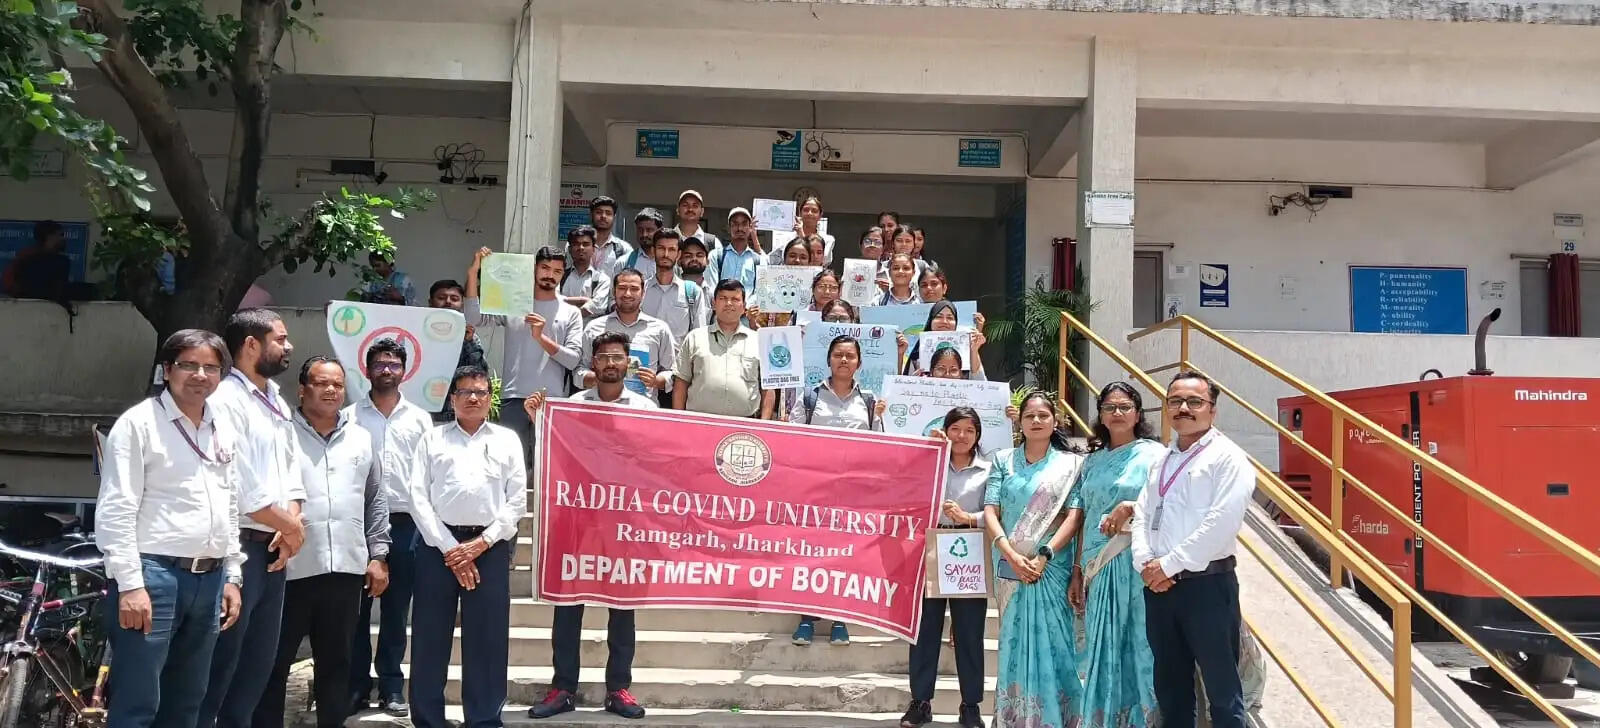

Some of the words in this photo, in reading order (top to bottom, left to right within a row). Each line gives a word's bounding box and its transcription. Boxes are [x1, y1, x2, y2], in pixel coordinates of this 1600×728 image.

[1564, 242, 1575, 251] 29
[1391, 280, 1426, 288] humanity
[1391, 296, 1427, 304] reliability
[1391, 312, 1416, 320] ability
[828, 326, 847, 337] SAY
[848, 327, 861, 337] NO
[1515, 389, 1588, 401] Mahindra
[1411, 431, 1421, 481] POER
[555, 480, 644, 512] RADHA
[652, 489, 756, 522] GOVIND
[766, 500, 923, 541] UNIVERSITY
[1413, 485, 1423, 548] EFICIENT
[616, 523, 727, 552] Ramgarh,
[733, 532, 854, 558] Jharkhand
[944, 563, 966, 576] SAY
[561, 553, 741, 586] DEPARTMENT
[748, 566, 784, 589] OF
[791, 566, 899, 608] BOTANY
[946, 575, 957, 583] TO
[958, 582, 979, 591] BAGS
